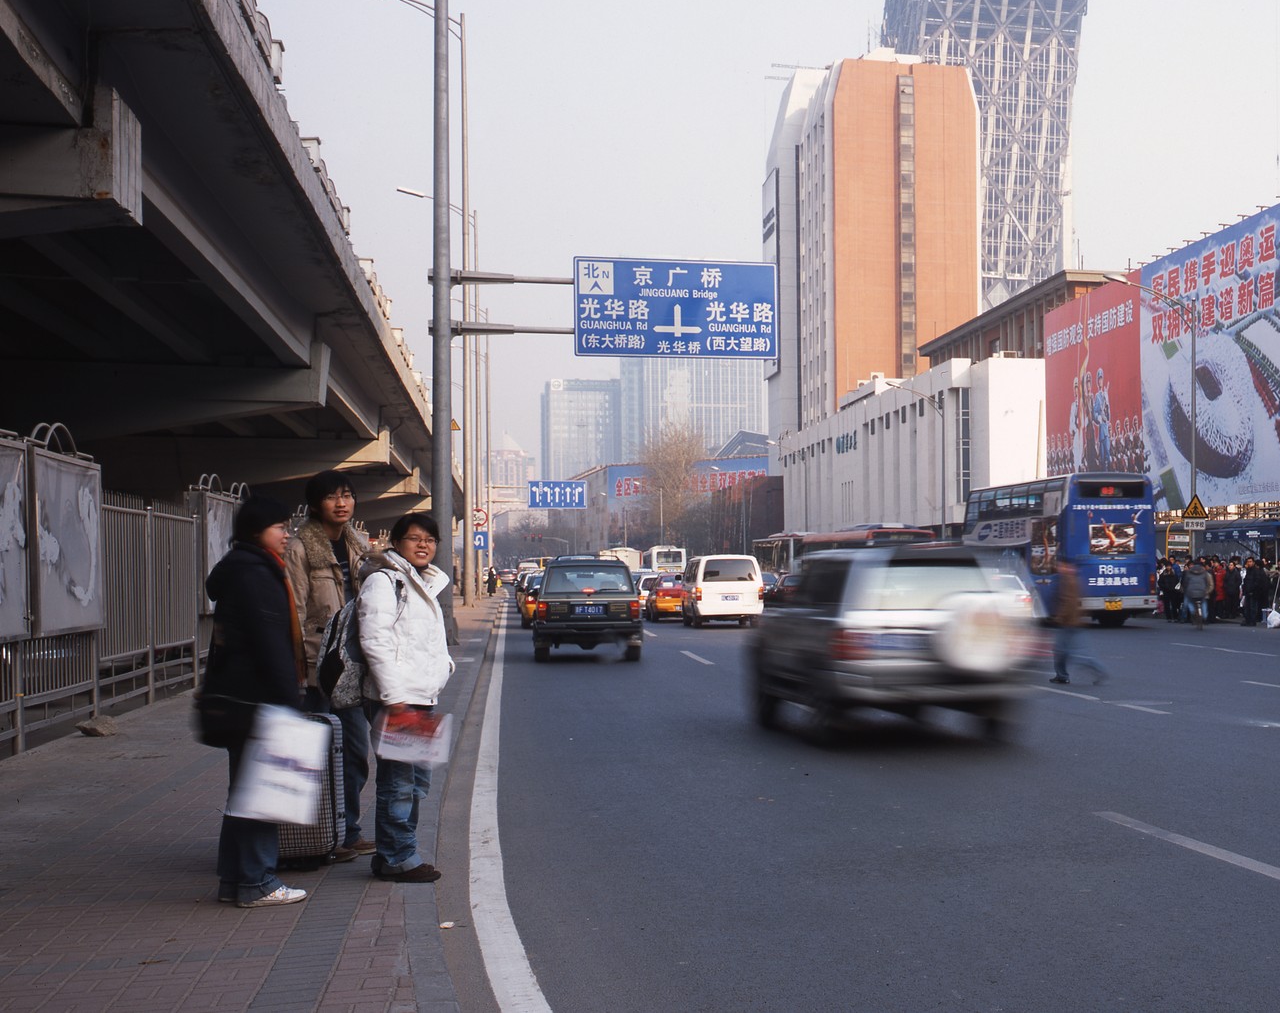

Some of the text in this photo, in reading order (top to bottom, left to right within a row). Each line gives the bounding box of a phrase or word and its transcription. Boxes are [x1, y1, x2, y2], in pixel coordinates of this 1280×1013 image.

[584, 263, 609, 279] 北 N
[1151, 224, 1276, 305] 军民携手迎奥运
[632, 265, 722, 288] 京广桥
[639, 288, 718, 300] JINGGUANG Bridge
[580, 298, 650, 320] 光华路
[706, 301, 774, 323] 光华路
[1151, 271, 1275, 344] 双拥共建谱新篇
[580, 320, 648, 331] GUANGHUA Rd
[708, 323, 771, 334] GUANGHUA Rd
[1046, 299, 1133, 356] 增强国防观念 支持国防建设
[581, 334, 645, 349] (东大桥路)
[657, 341, 701, 354] 光华桥
[706, 336, 771, 352] (西大望路)
